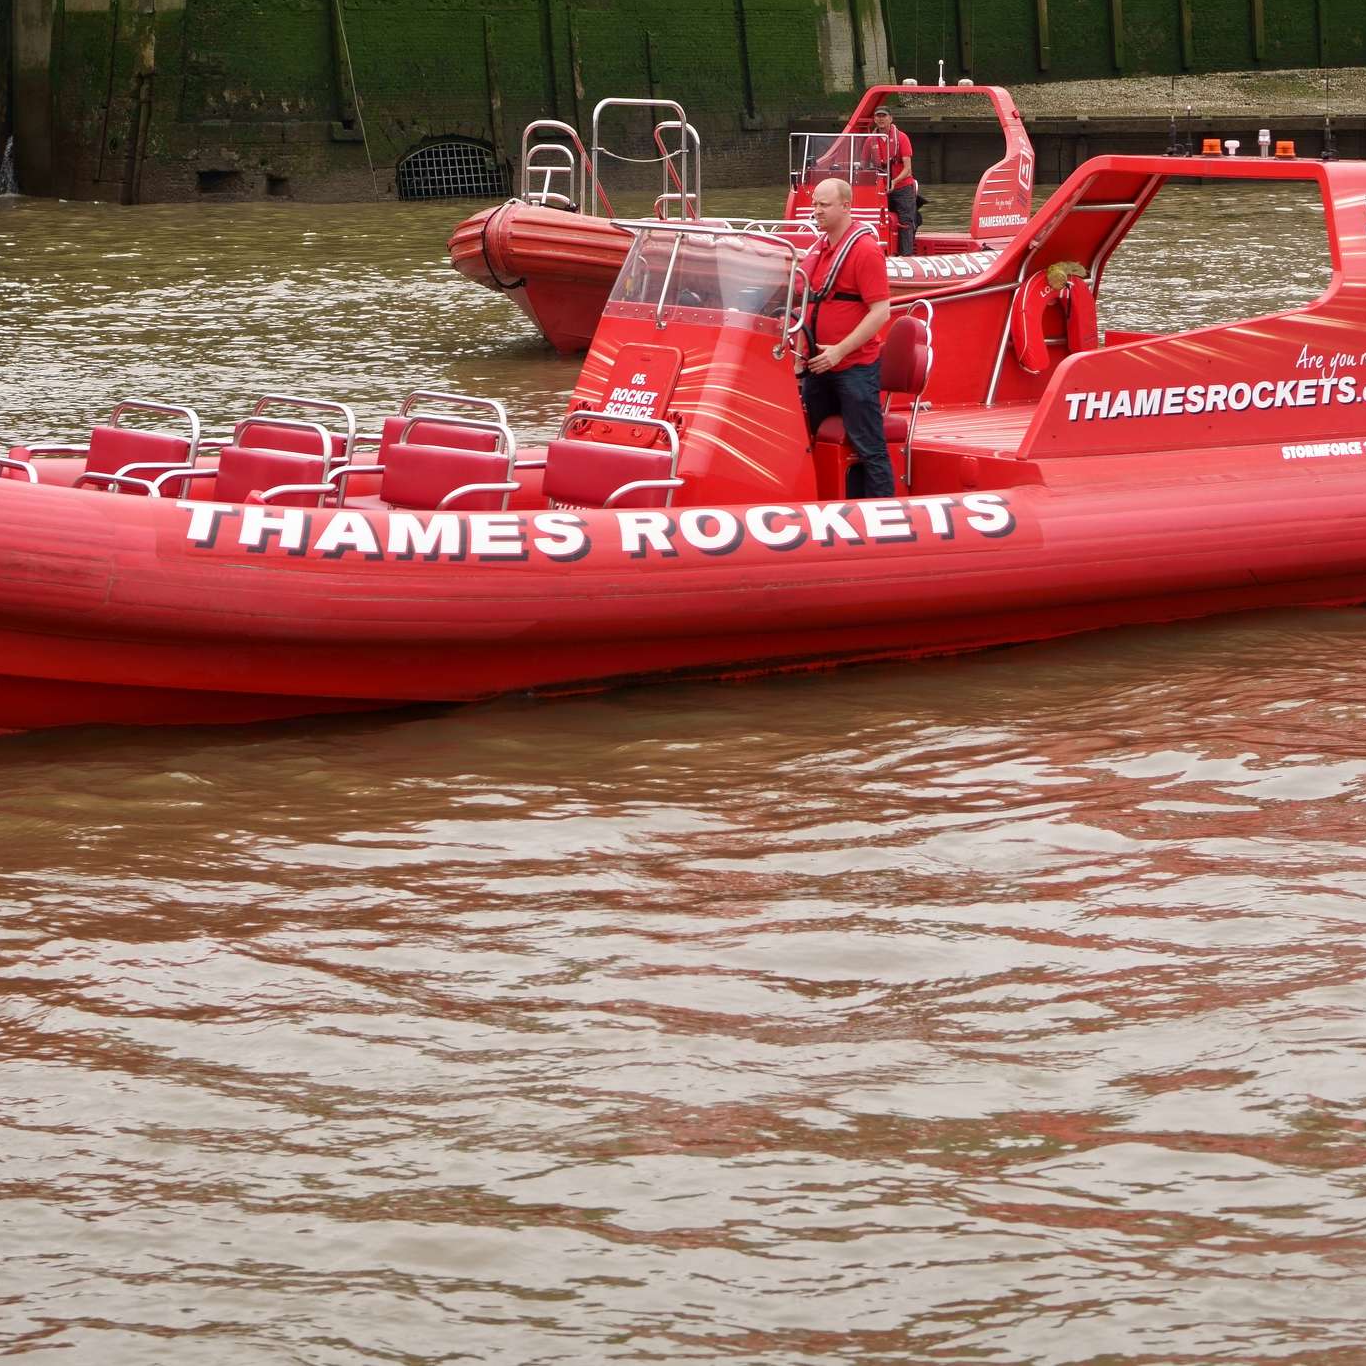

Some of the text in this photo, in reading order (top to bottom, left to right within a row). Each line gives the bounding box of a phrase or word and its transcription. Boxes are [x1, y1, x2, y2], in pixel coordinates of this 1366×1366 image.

[912, 250, 1004, 278] ROCKE
[1296, 344, 1324, 369] Are
[1322, 352, 1356, 380] you
[610, 387, 658, 405] ROCKET
[603, 401, 655, 419] SCIENCE
[1281, 442, 1363, 460] STORMFORCE
[176, 493, 1013, 559] THAMES ROCKETS
